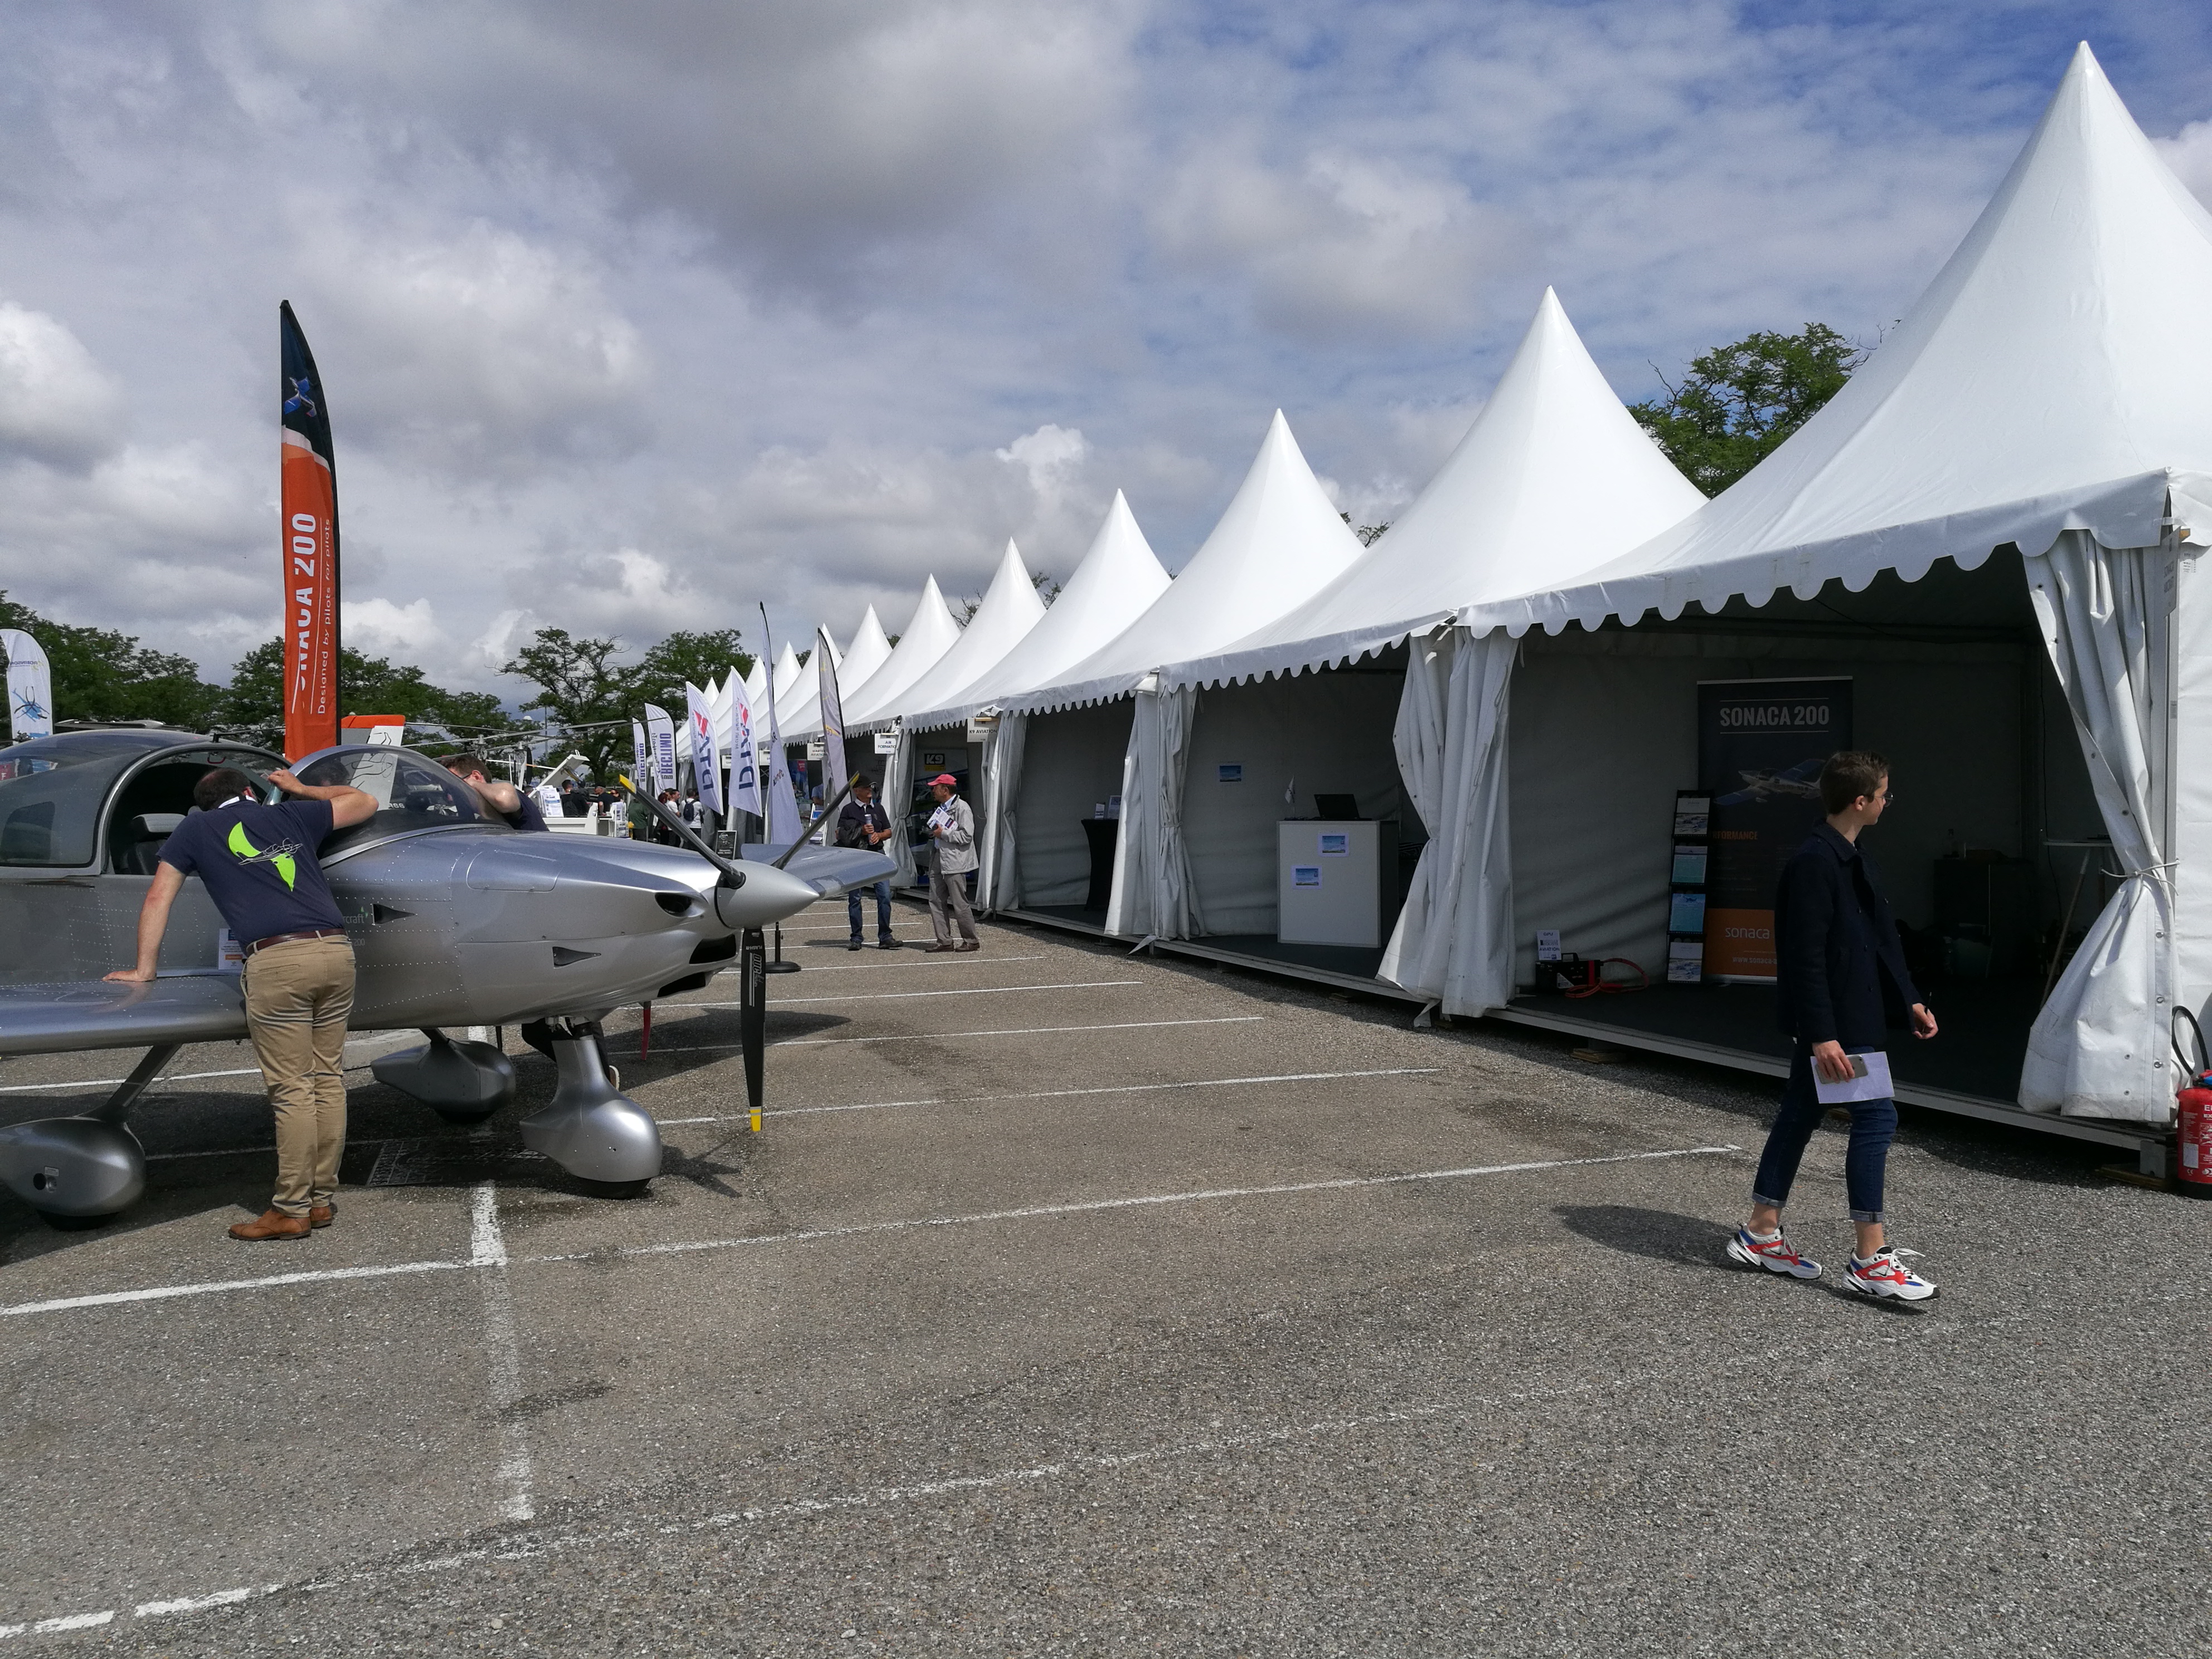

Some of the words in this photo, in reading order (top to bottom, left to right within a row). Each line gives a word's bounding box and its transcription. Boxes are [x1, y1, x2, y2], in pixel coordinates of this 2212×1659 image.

[292, 513, 316, 577] 200
[318, 651, 328, 714] Designed
[323, 629, 329, 646] by
[1720, 706, 1791, 726] SONACA
[1794, 705, 1829, 725] 200
[926, 754, 944, 764] K9
[1725, 928, 1769, 939] sonaca
